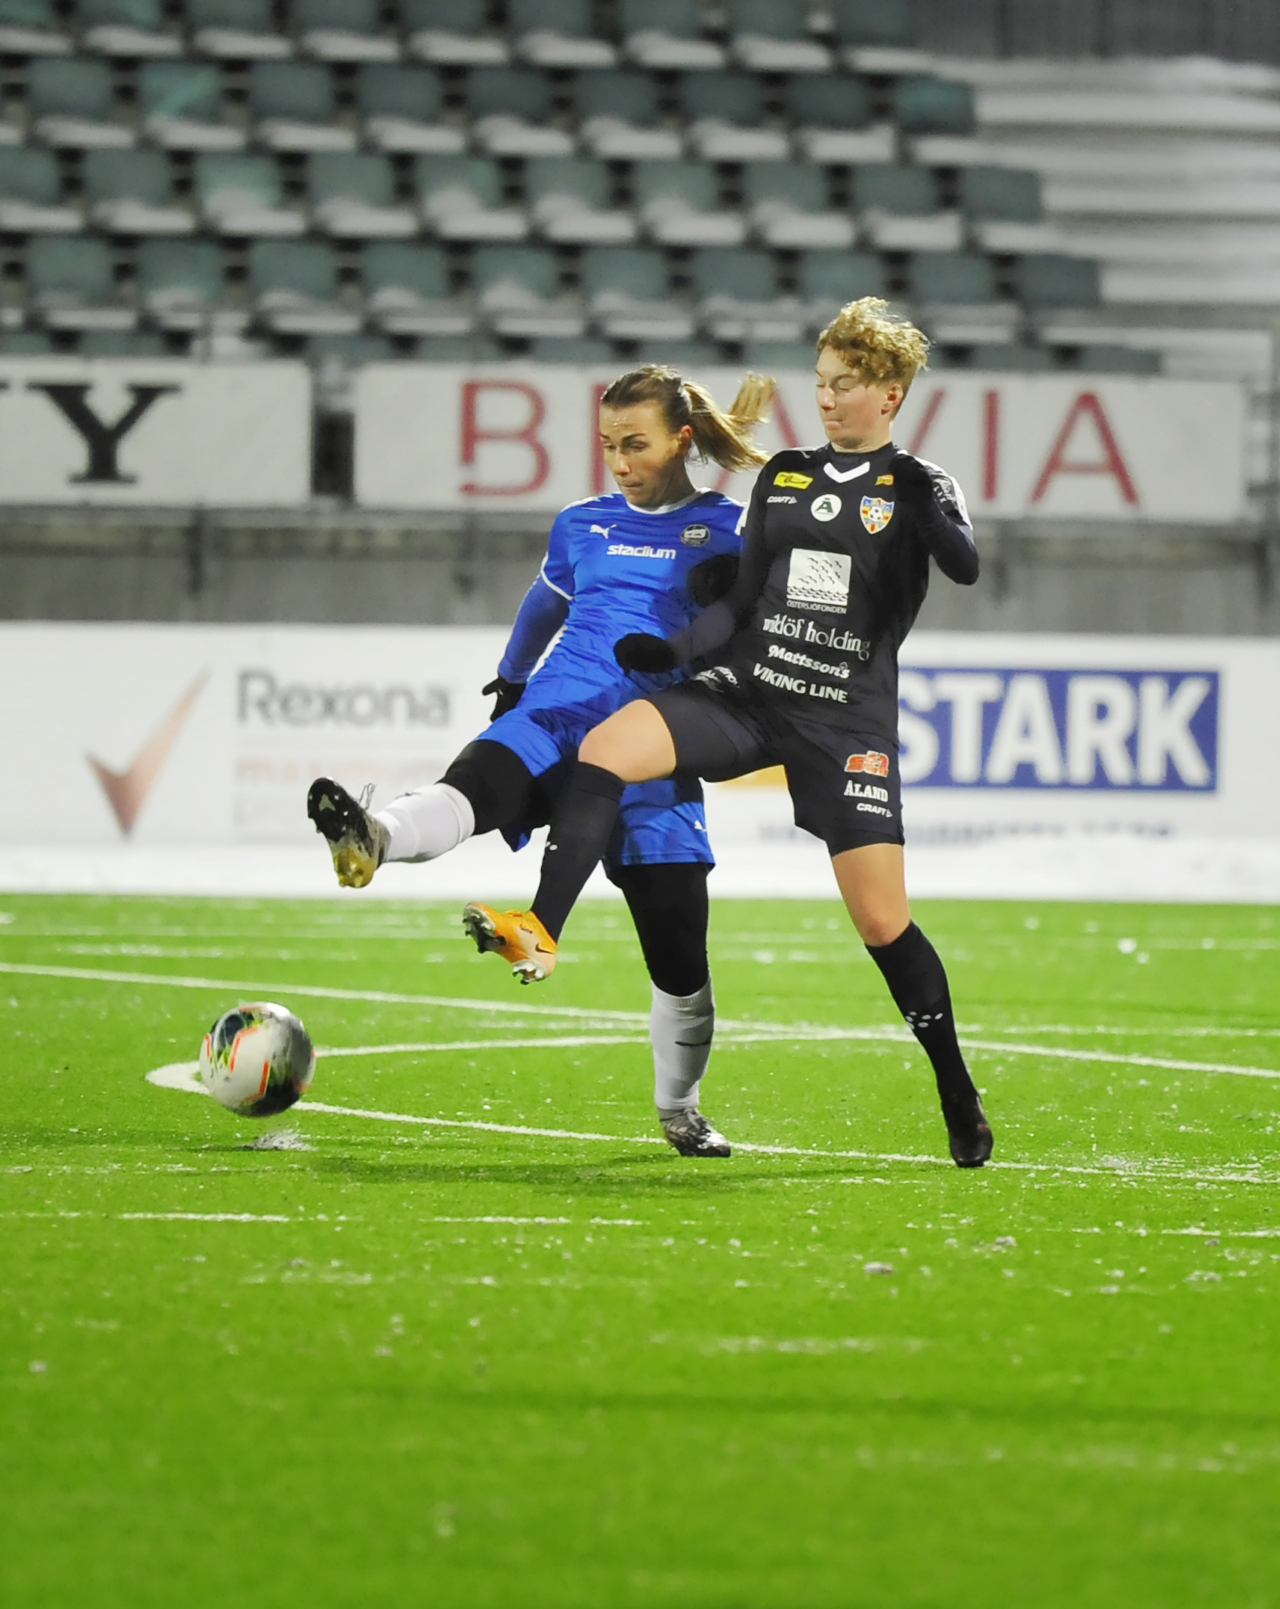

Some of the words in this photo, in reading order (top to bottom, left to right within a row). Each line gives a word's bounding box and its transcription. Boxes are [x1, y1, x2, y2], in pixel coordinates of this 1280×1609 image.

[0, 381, 183, 484] Y
[460, 379, 1141, 507] BIA
[606, 543, 676, 560] stadium
[787, 600, 847, 614] ÖSTERSJÖFONDEN
[805, 621, 871, 661] holding
[237, 668, 453, 729] Rexona
[753, 663, 806, 694] VIKING
[809, 683, 849, 703] LINE
[898, 673, 1213, 786] STARK
[843, 780, 889, 802] ÅLAND
[856, 802, 888, 816] CRAFT
